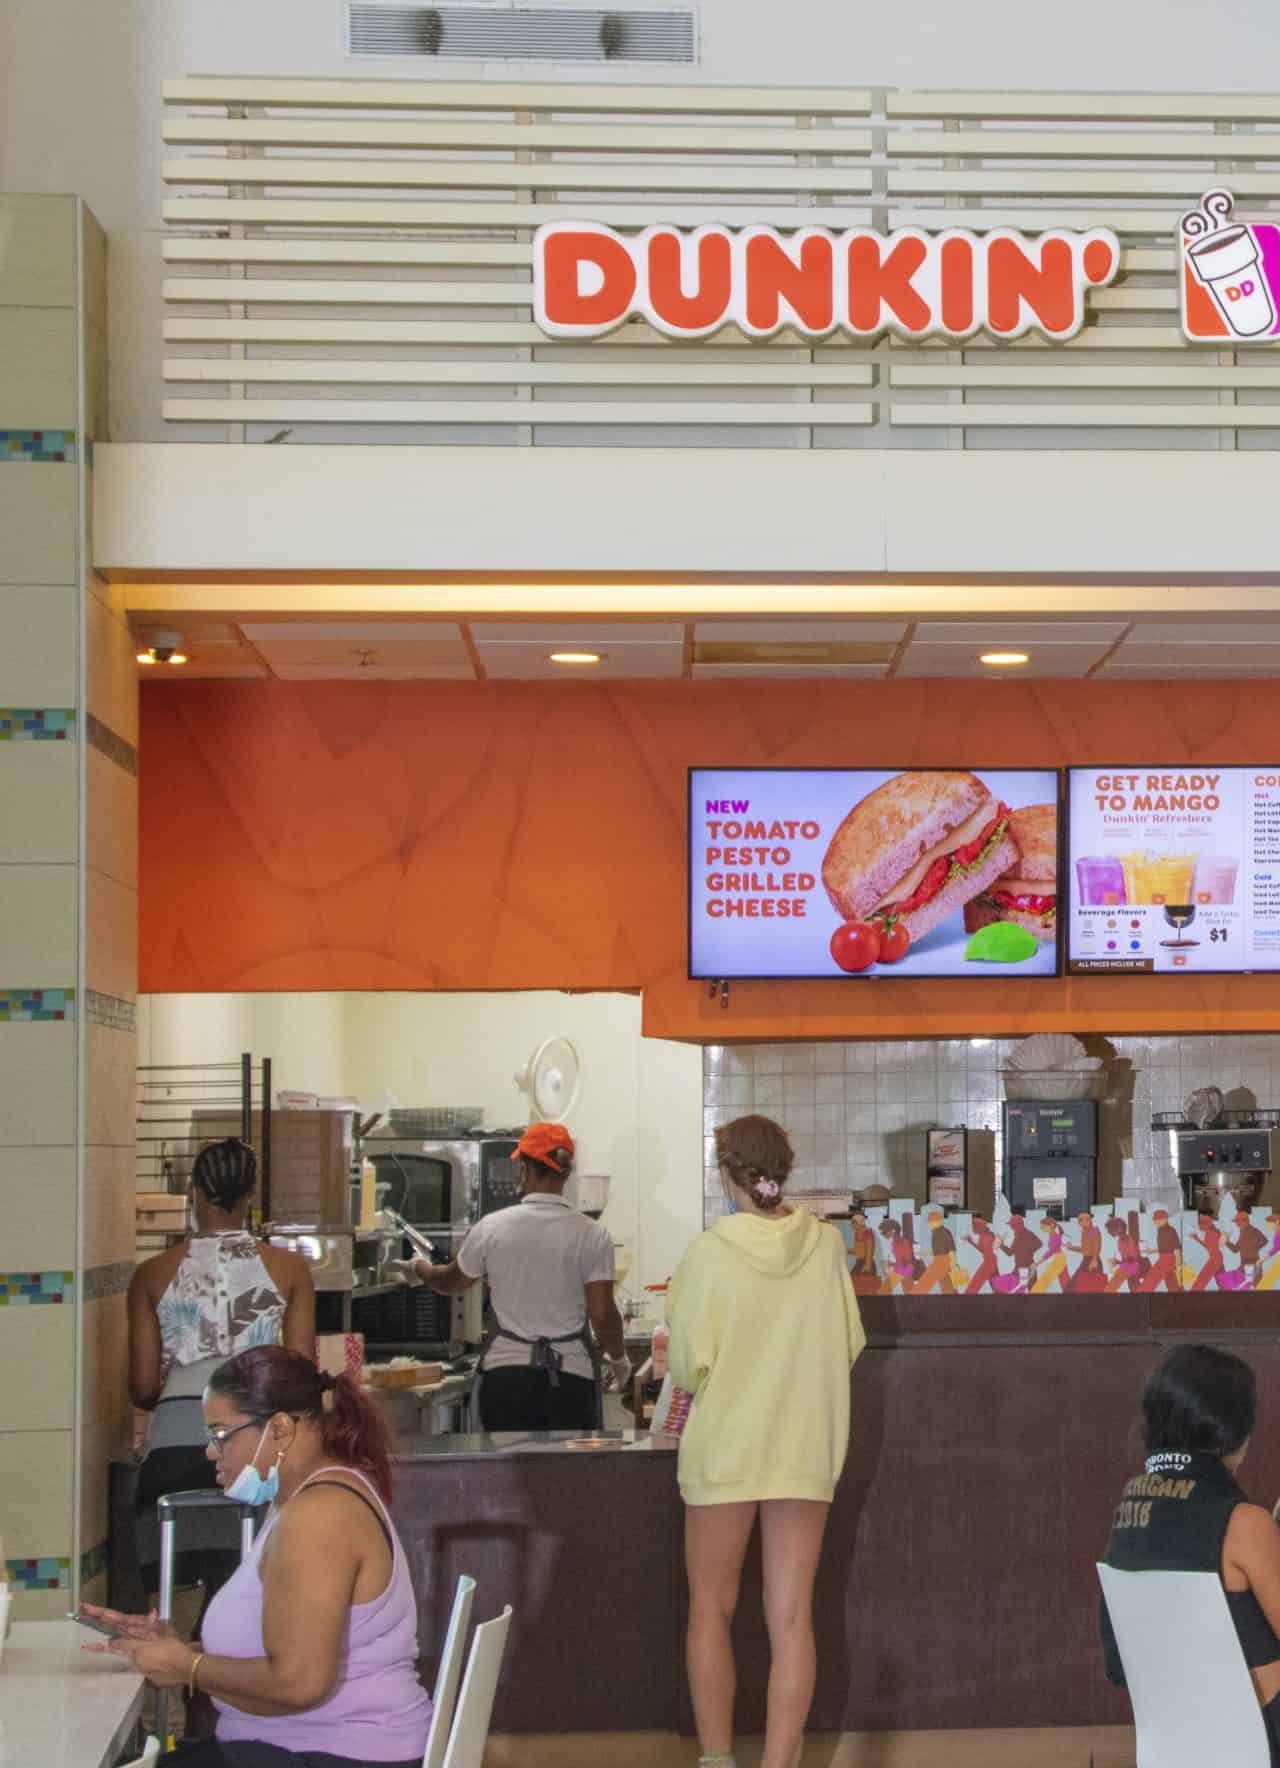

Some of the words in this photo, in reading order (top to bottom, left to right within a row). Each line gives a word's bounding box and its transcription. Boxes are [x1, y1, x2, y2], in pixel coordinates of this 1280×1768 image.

[544, 231, 1113, 332] DUNKIN'
[1225, 280, 1255, 302] DD
[1095, 775, 1139, 791] GET
[1146, 774, 1221, 791] READY
[705, 800, 749, 814] NEW
[1095, 795, 1126, 811] TO
[1133, 795, 1220, 811] MANGO
[706, 821, 820, 839] TOMATO
[706, 847, 791, 865] PESTO
[706, 873, 815, 892] GRILLED
[706, 899, 806, 918] CHEESE
[1209, 928, 1227, 943] $1
